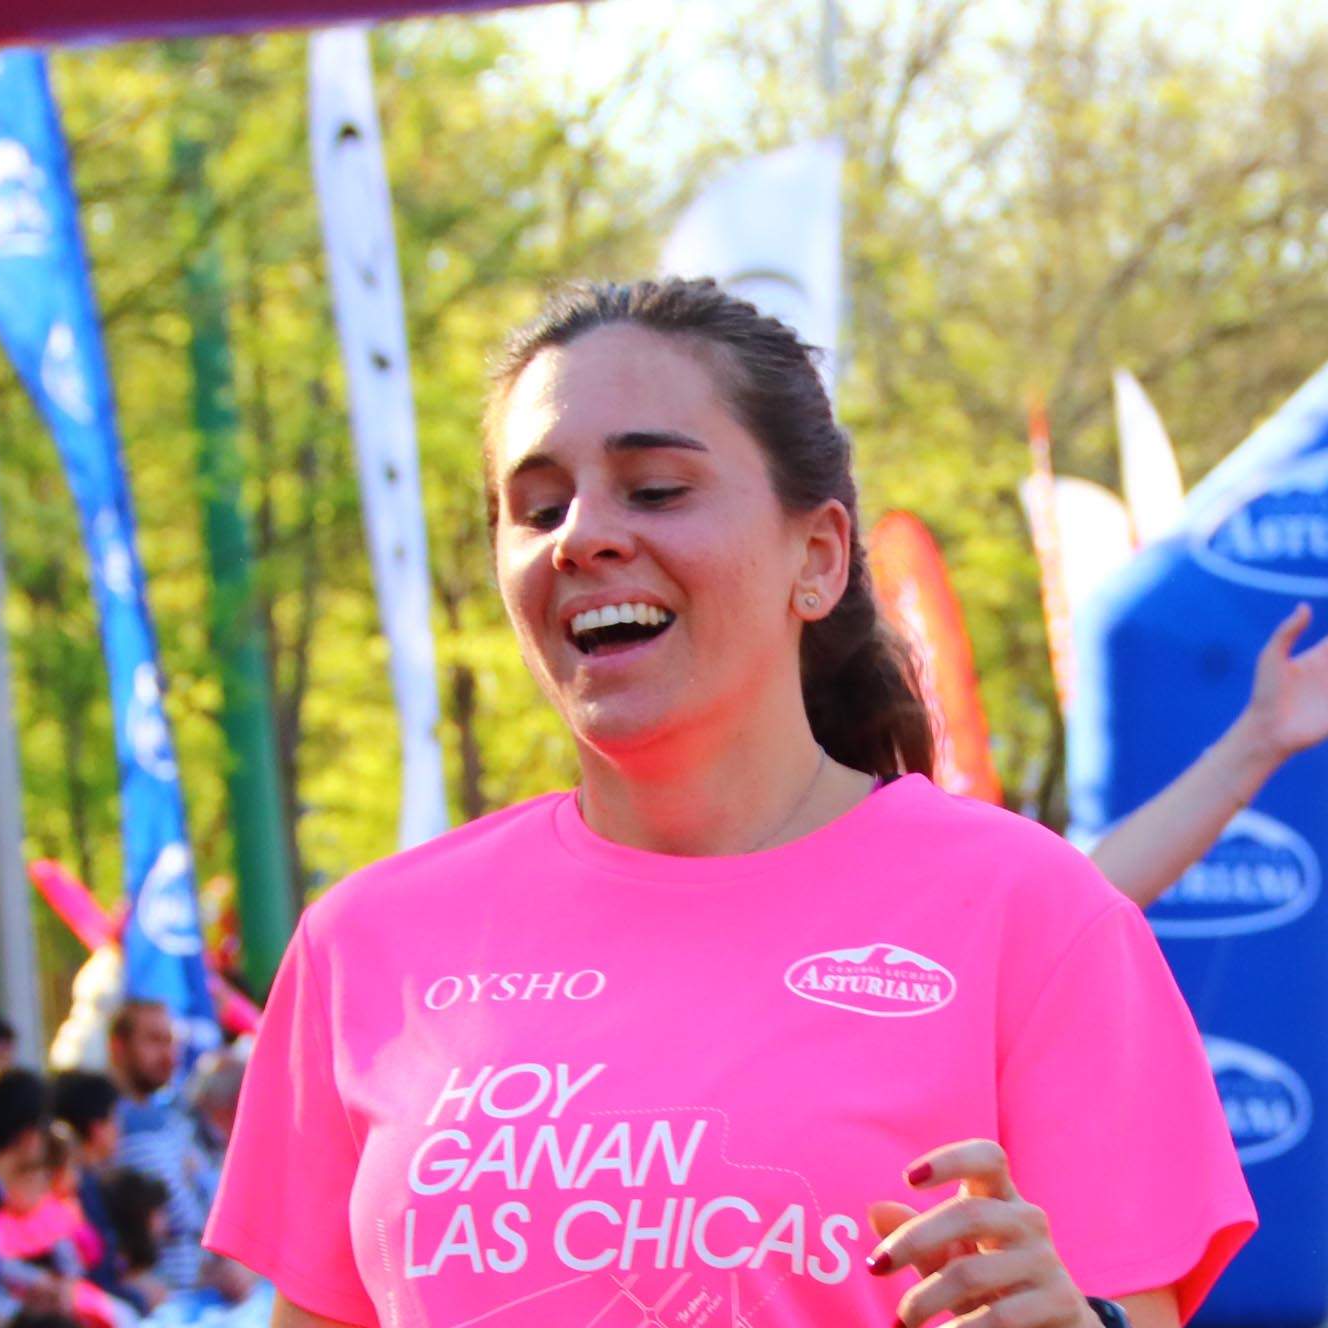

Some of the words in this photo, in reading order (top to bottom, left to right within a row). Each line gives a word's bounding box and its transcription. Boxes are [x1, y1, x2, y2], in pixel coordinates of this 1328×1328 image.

[424, 969, 606, 1011] OYSHO
[796, 964, 943, 1004] ASTURIANA
[426, 1063, 607, 1126] HOY
[407, 1120, 707, 1196] GANAN
[404, 1201, 531, 1280] LAS
[554, 1196, 859, 1286] CHICAS
